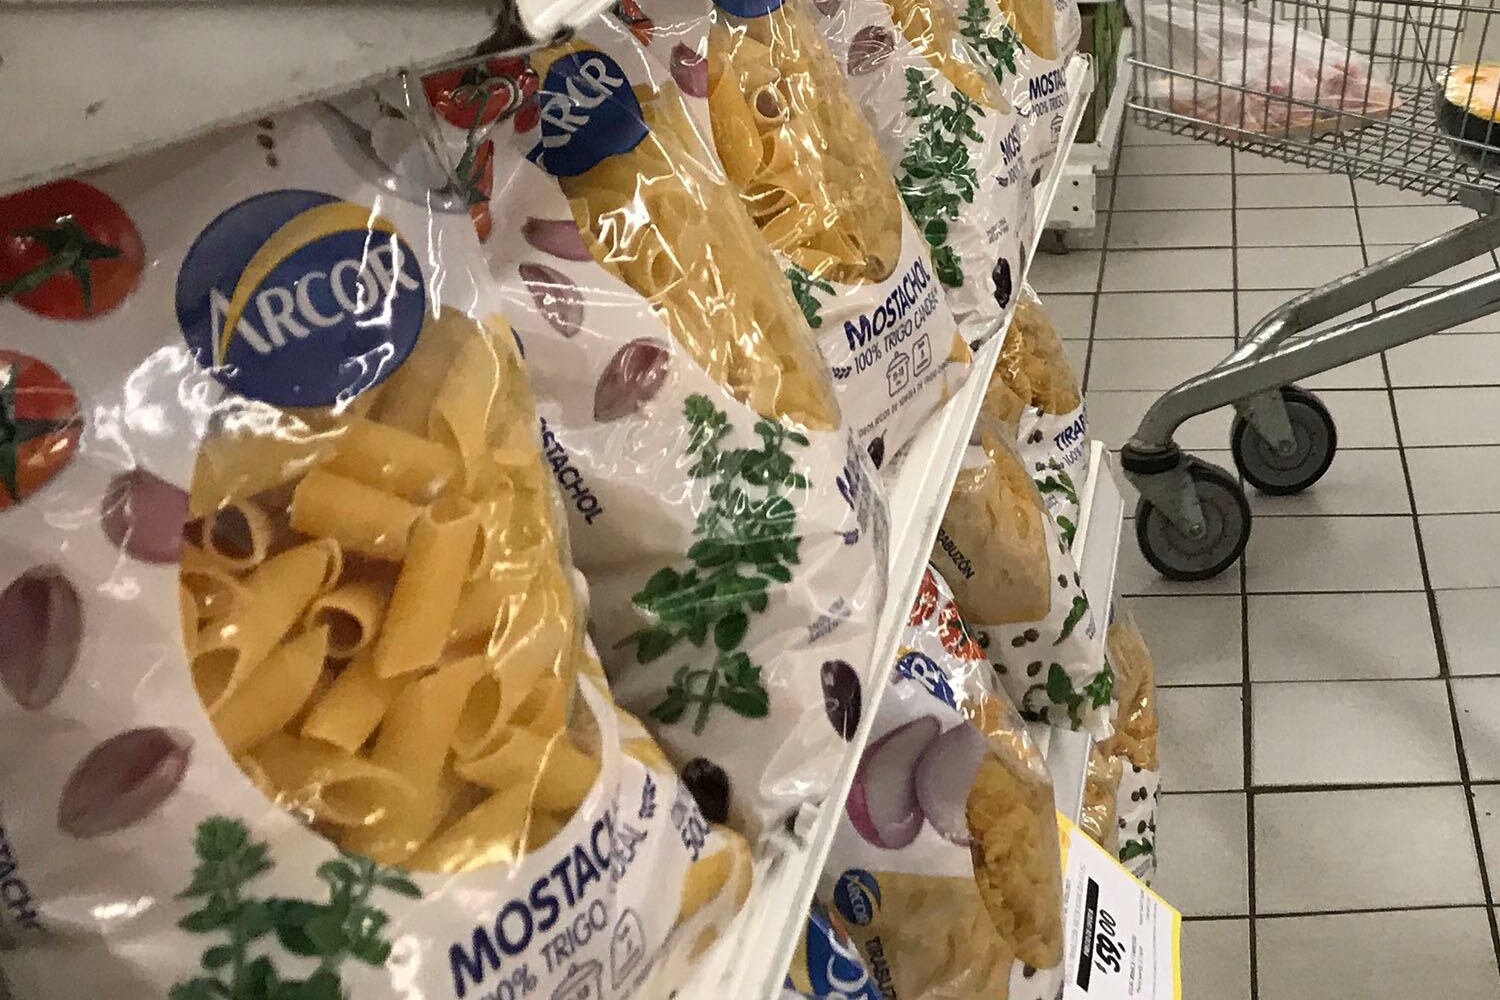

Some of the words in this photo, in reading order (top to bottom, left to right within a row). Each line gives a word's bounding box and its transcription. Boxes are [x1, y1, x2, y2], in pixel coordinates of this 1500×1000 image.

[208, 242, 420, 369] ARCOR
[844, 256, 931, 351] MOSTACHOL
[854, 342, 882, 375] 100%
[884, 319, 914, 352] TRIGO
[540, 417, 603, 525] STACHOL
[938, 529, 975, 580] RABUZÓN
[448, 810, 612, 999] MOSTAC
[539, 899, 608, 972] TRIGO
[843, 874, 870, 925] ARCOR
